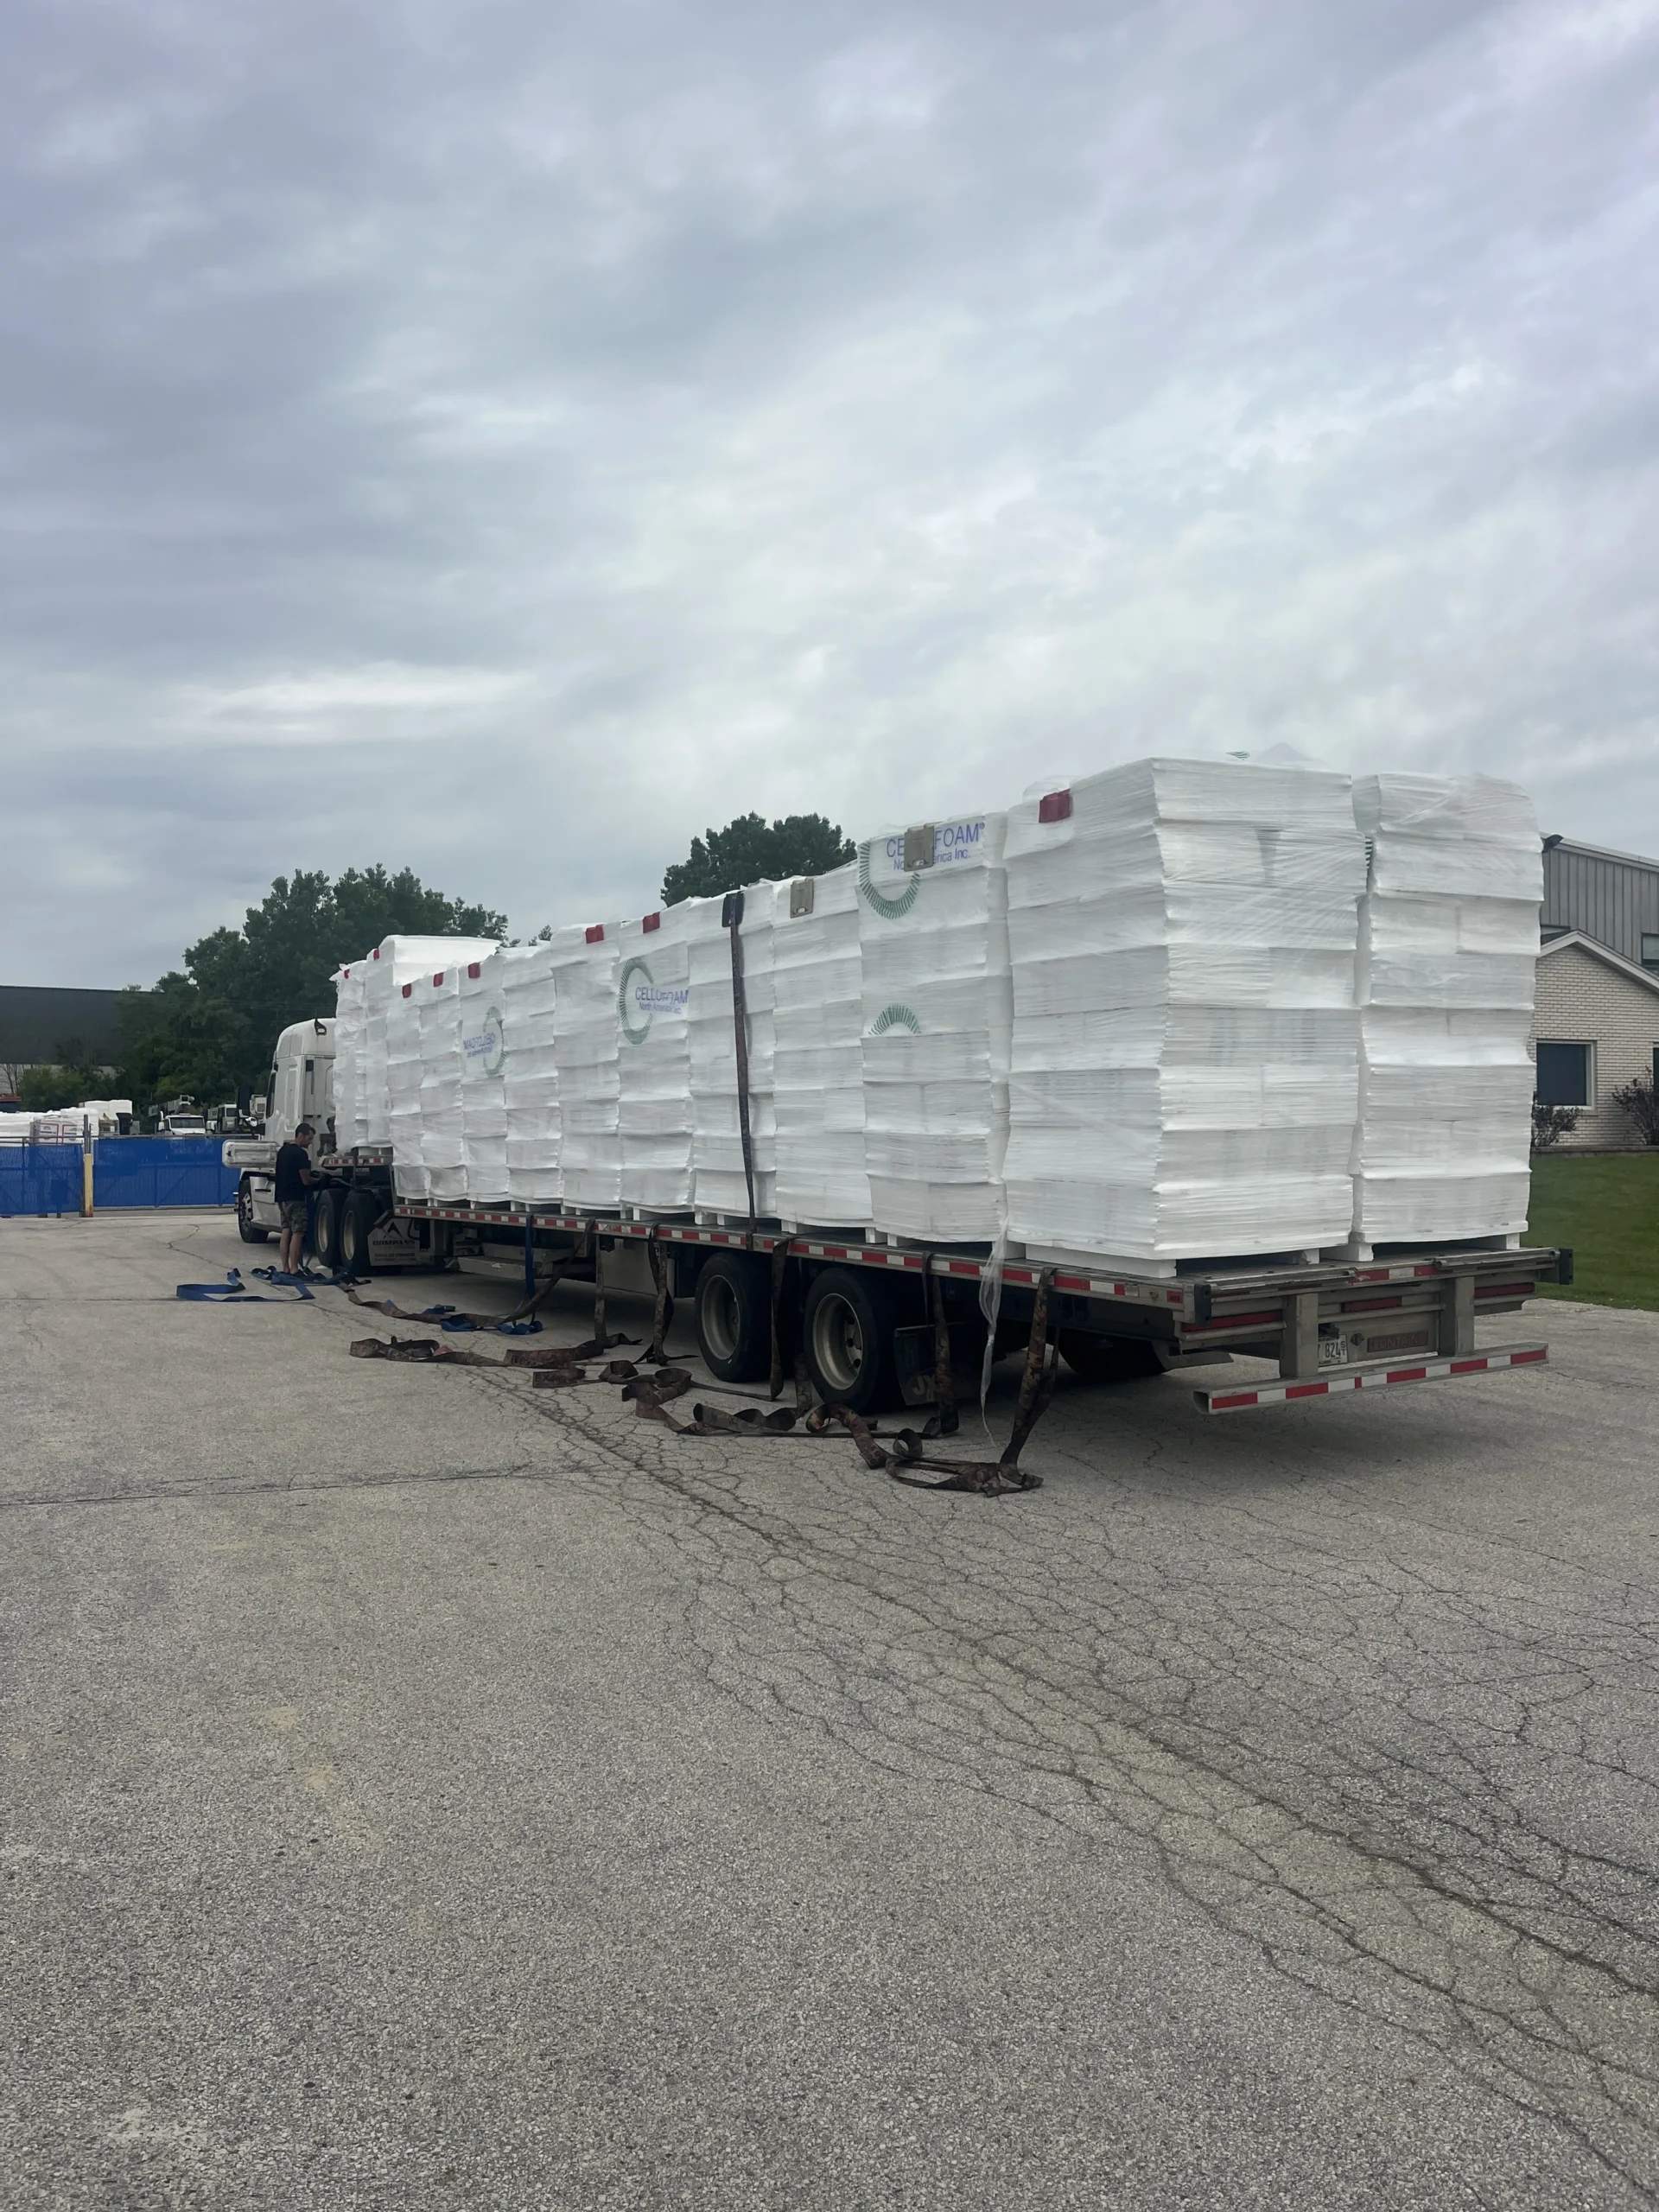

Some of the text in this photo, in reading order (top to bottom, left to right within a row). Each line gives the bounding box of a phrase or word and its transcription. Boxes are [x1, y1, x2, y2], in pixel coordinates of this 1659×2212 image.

[887, 822, 985, 857] CEFOAM®
[955, 848, 971, 860] Inc.
[635, 987, 689, 1005] CELLOFOAM
[1325, 1342, 1341, 1357] 824
